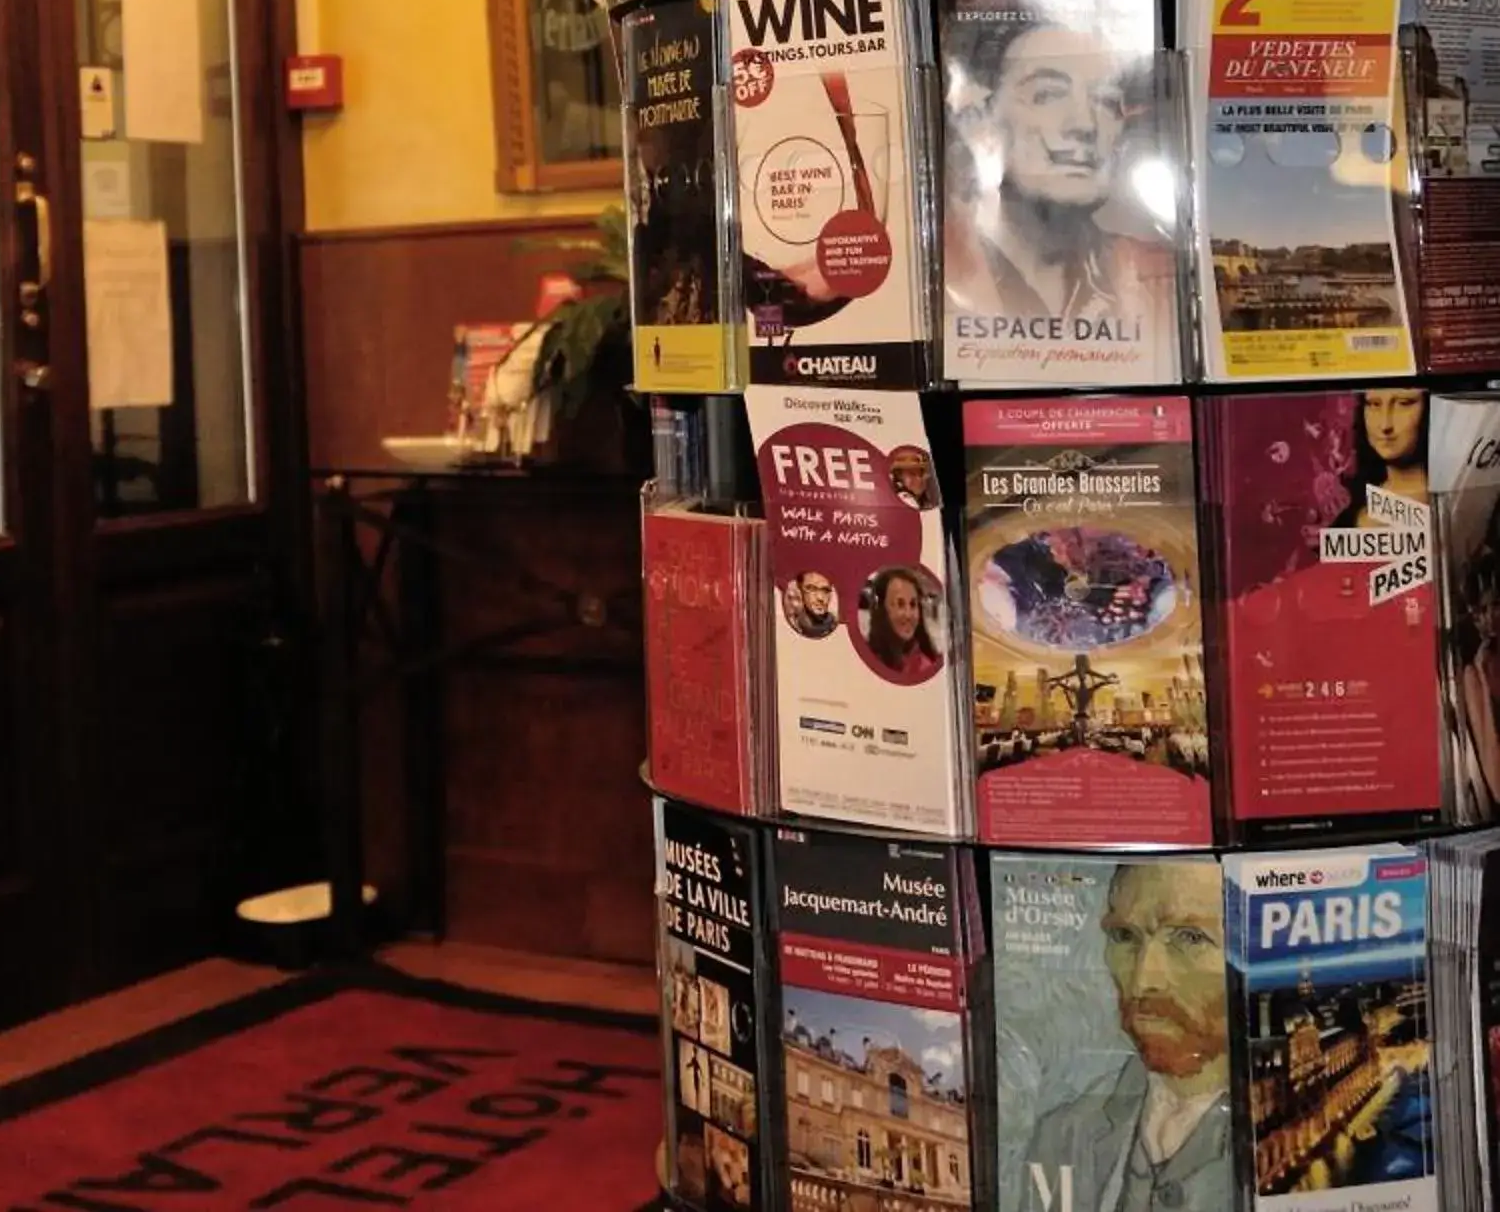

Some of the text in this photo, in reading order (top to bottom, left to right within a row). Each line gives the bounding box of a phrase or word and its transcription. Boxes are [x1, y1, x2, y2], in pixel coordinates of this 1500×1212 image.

[1248, 39, 1357, 57] VEDETTES
[1225, 58, 1377, 78] DU PONT-NEUF
[800, 166, 833, 180] WINE
[956, 316, 1063, 340] ESPACE
[771, 444, 875, 491] FREE
[982, 470, 1163, 496] Les Grandes Brasseries
[781, 505, 879, 528] WALK PARIS
[1370, 491, 1426, 528] PARIS
[781, 525, 889, 549] WITH A NATIVE
[1324, 531, 1426, 557] MUSEUM
[1374, 555, 1428, 598] PASS
[1305, 680, 1315, 698] 2
[1320, 681, 1330, 697] 4
[665, 841, 723, 883] MUSÉES
[883, 871, 946, 899] Musée
[1256, 869, 1307, 888] where
[665, 870, 751, 927] DE LA VILLE
[783, 884, 948, 928] Jacquemart-André
[665, 901, 731, 954] DE PARIS
[1260, 890, 1404, 950] PARIS
